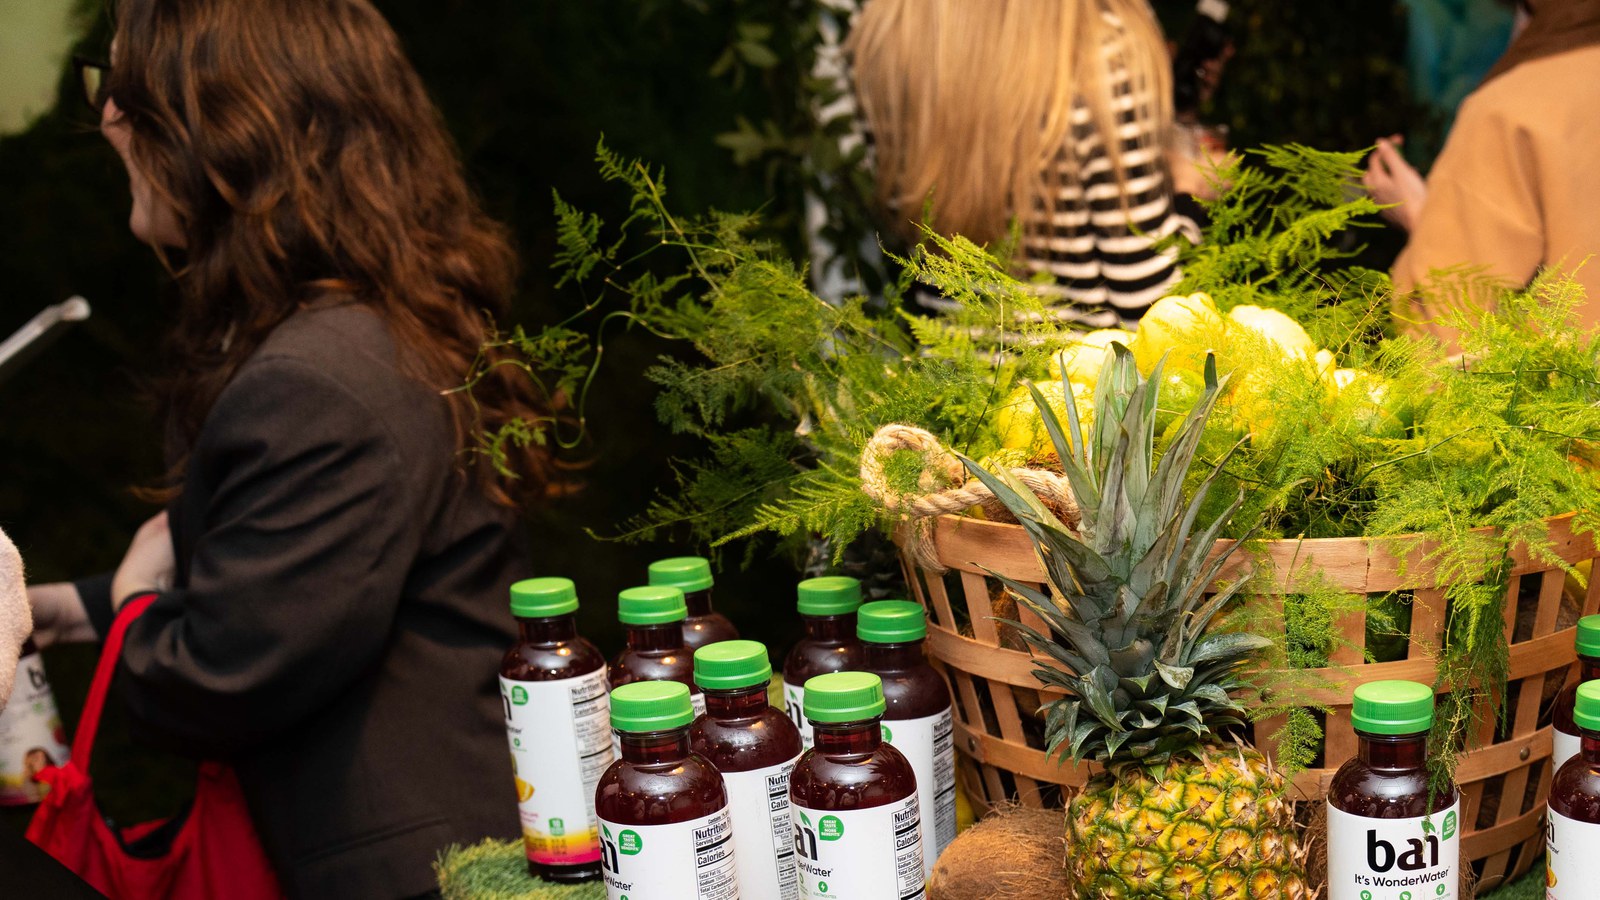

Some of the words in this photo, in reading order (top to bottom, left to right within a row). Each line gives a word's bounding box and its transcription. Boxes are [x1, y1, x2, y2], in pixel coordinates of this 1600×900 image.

[768, 772, 790, 786] Nutri
[771, 800, 788, 809] Calo
[695, 821, 727, 840] Nutrition
[795, 816, 818, 861] ai
[695, 837, 714, 847] Serving
[896, 832, 919, 848] Calories
[600, 829, 619, 874] ai
[697, 849, 726, 866] Calories
[1366, 826, 1439, 873] bai
[1354, 873, 1370, 886] It's
[1372, 868, 1449, 887] WonderWater
